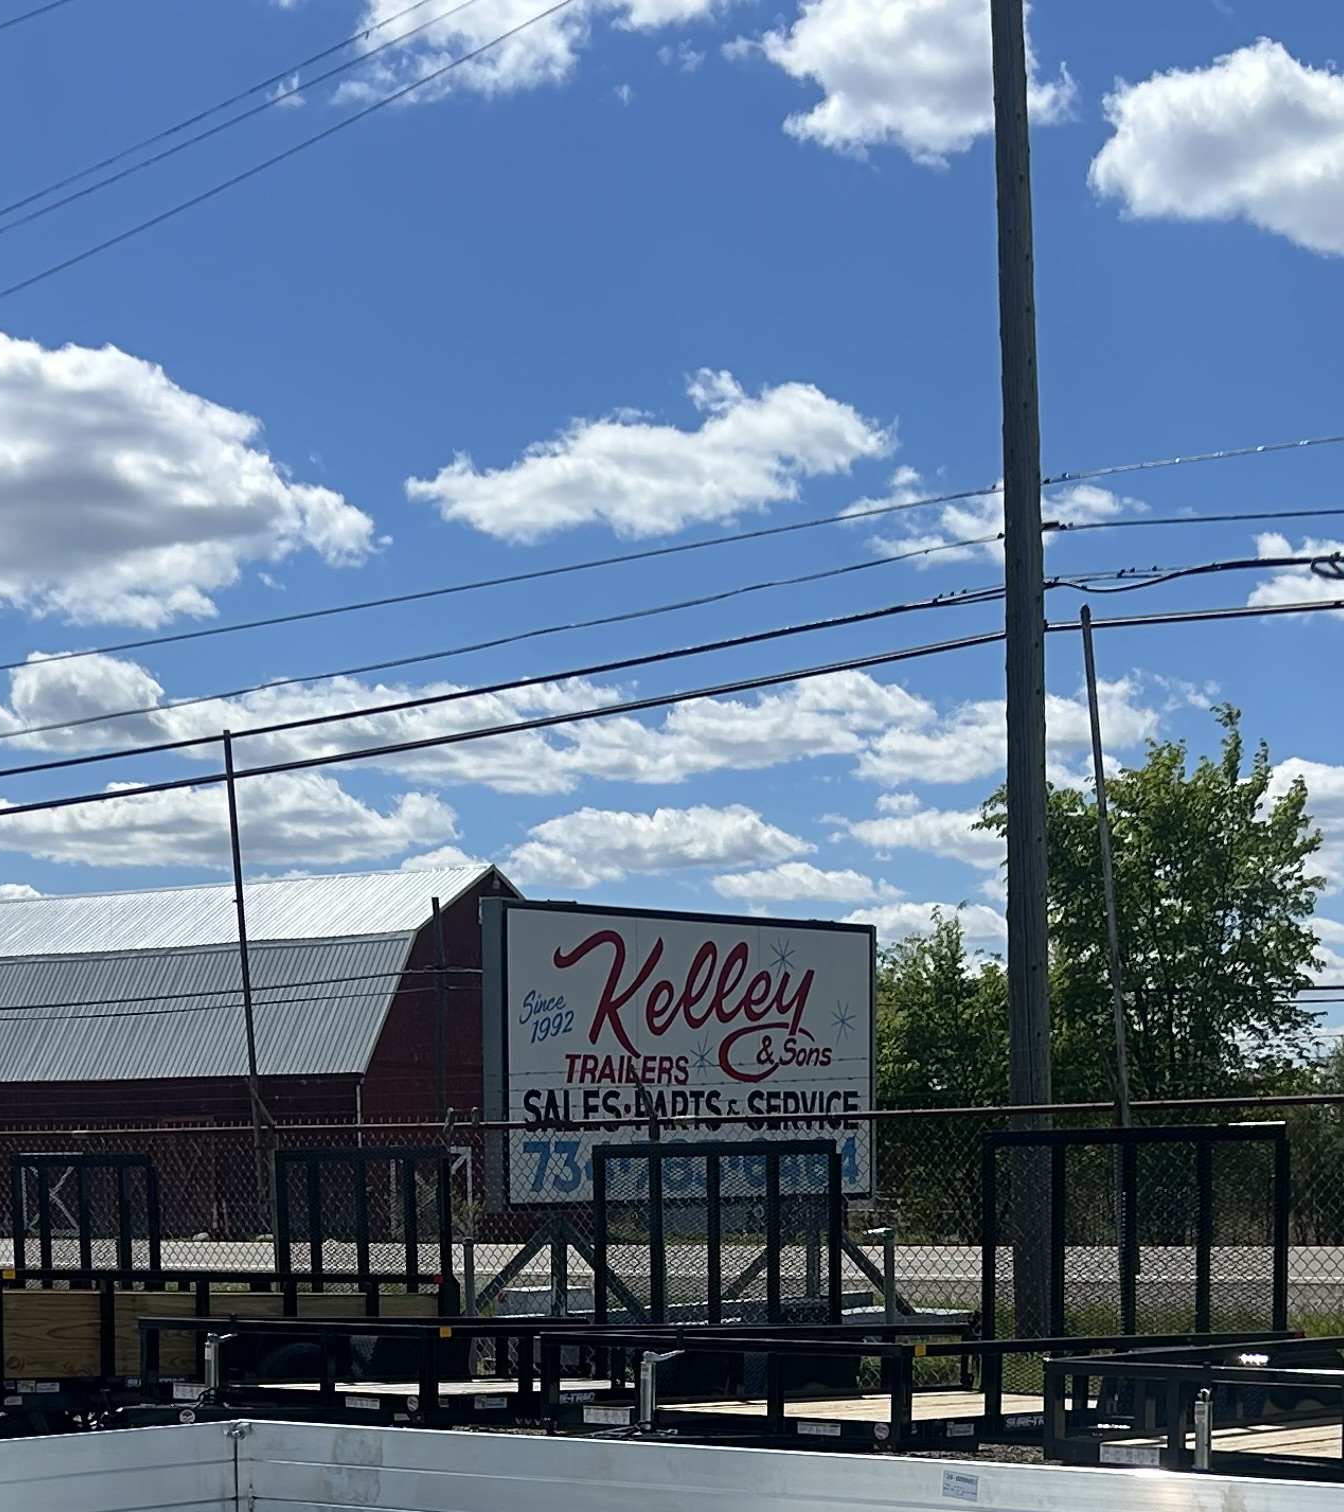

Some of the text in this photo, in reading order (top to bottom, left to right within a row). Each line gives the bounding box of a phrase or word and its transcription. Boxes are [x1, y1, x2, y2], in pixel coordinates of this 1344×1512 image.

[519, 990, 566, 1025] Since
[554, 930, 815, 1059] Kelley
[530, 1011, 575, 1044] 1992
[756, 1035, 832, 1068] & Sons
[565, 1054, 689, 1085] TRAILERS
[747, 1090, 860, 1131] SERVICE
